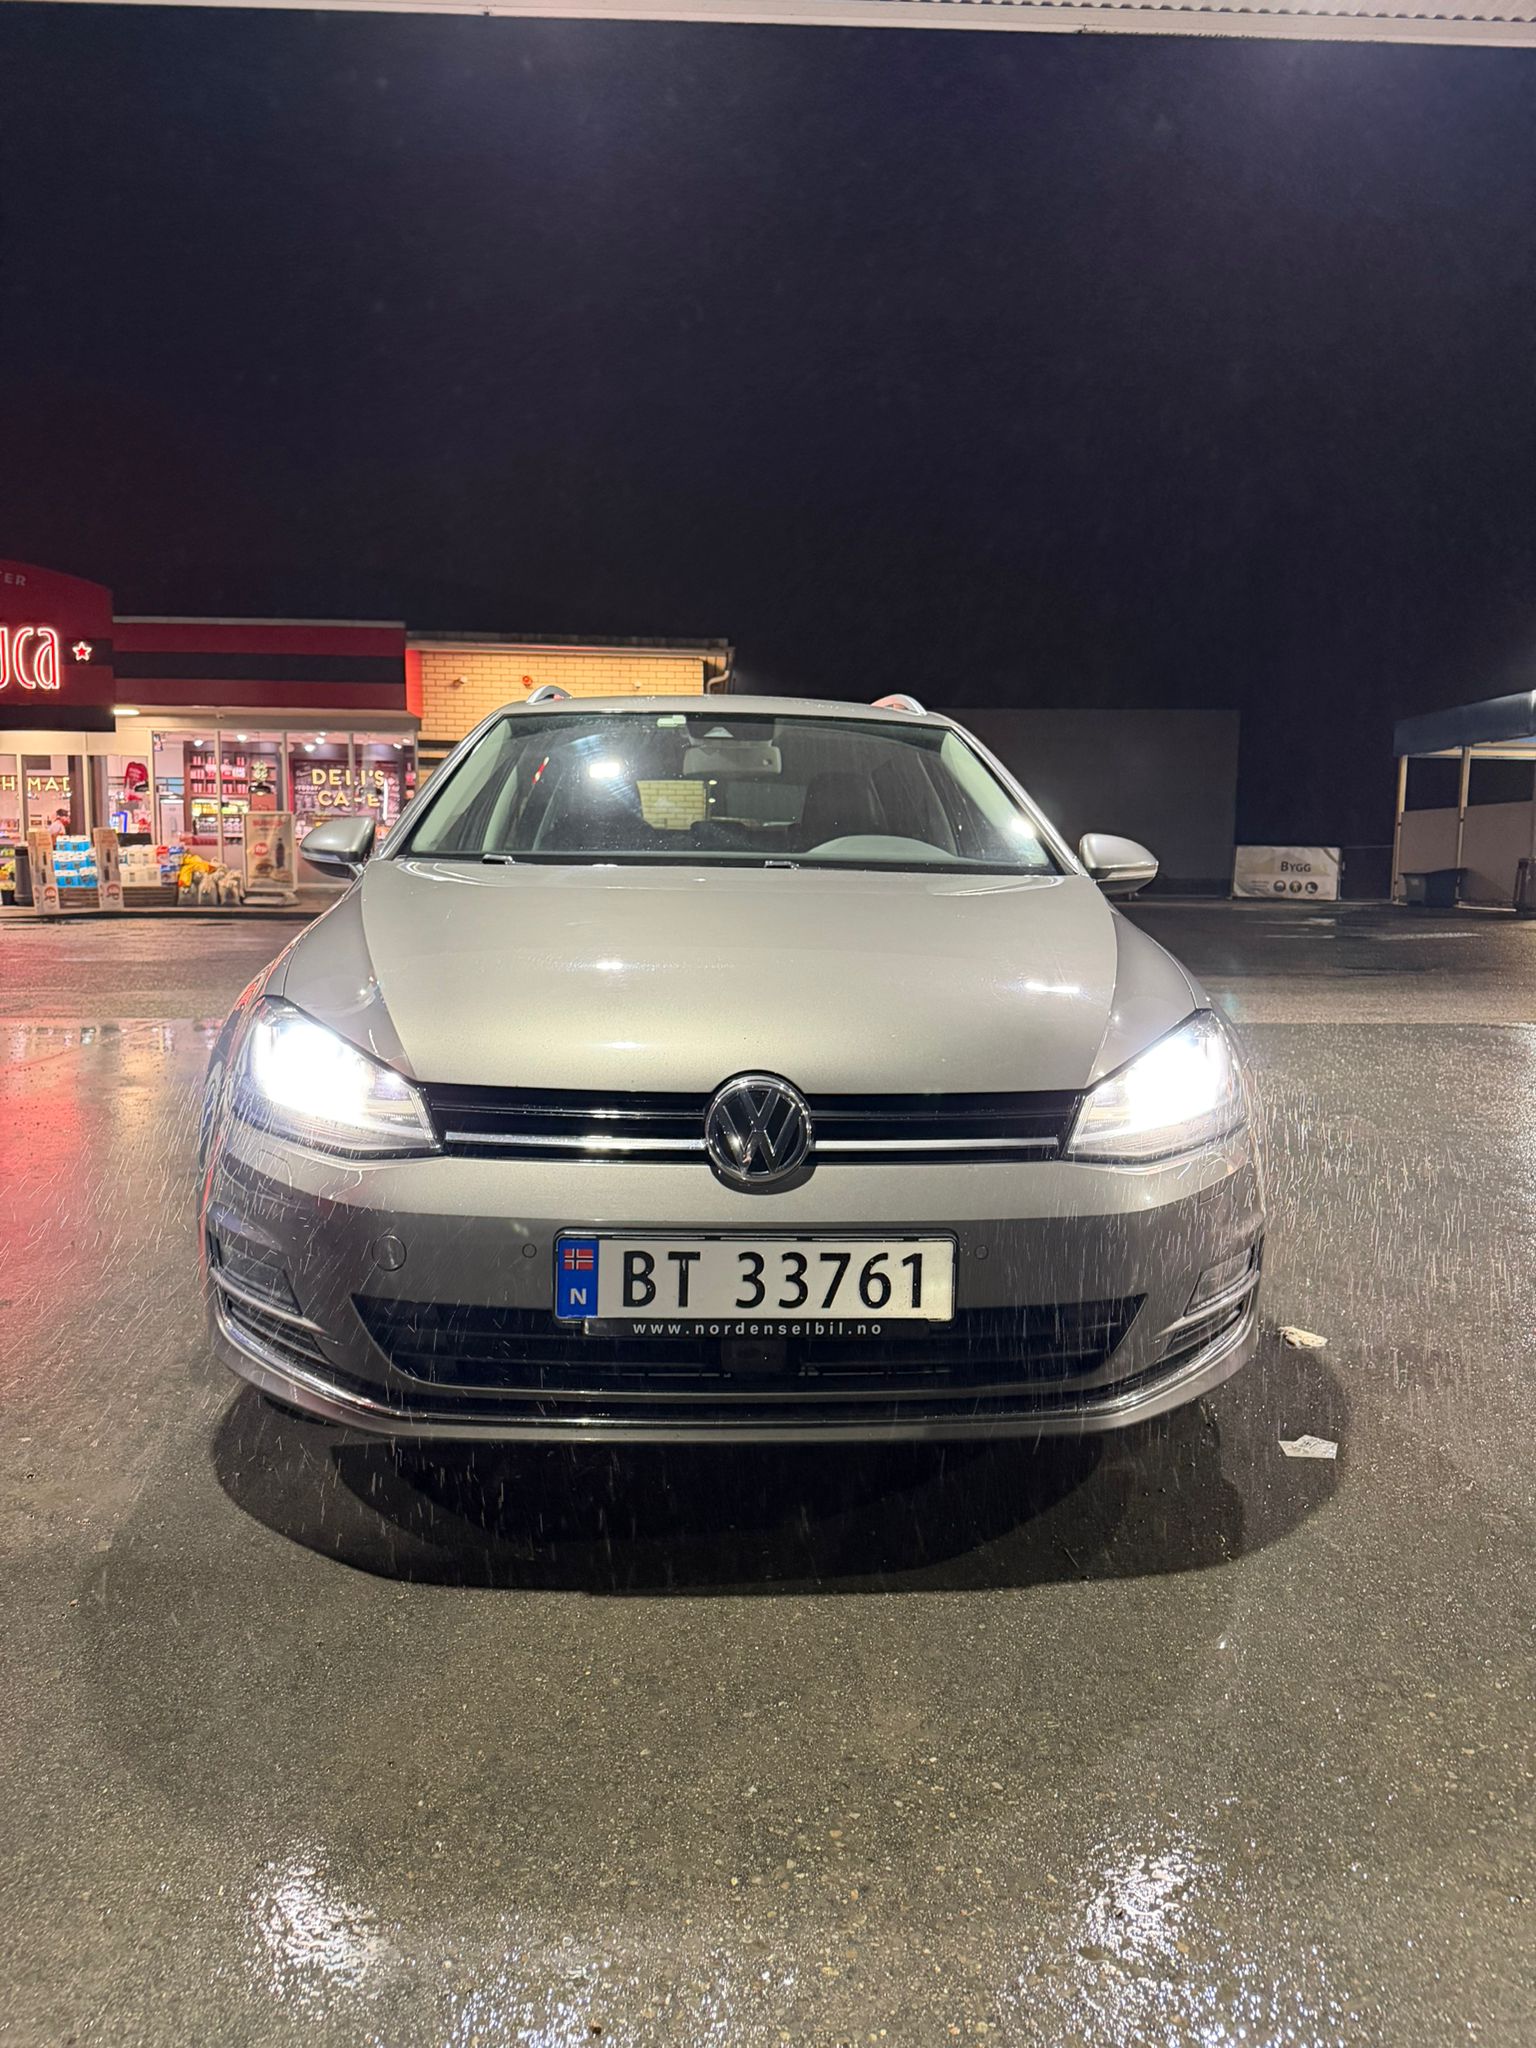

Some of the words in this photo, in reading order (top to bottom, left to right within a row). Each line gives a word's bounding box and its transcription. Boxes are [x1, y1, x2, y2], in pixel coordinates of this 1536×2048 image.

[0, 571, 26, 586] ER
[311, 768, 385, 786] DELI'S
[318, 790, 381, 808] CAE
[622, 1250, 701, 1309] BT
[735, 1251, 924, 1309] 33761
[570, 1287, 587, 1305] N
[633, 1320, 882, 1336] www.nordenselbil.no
